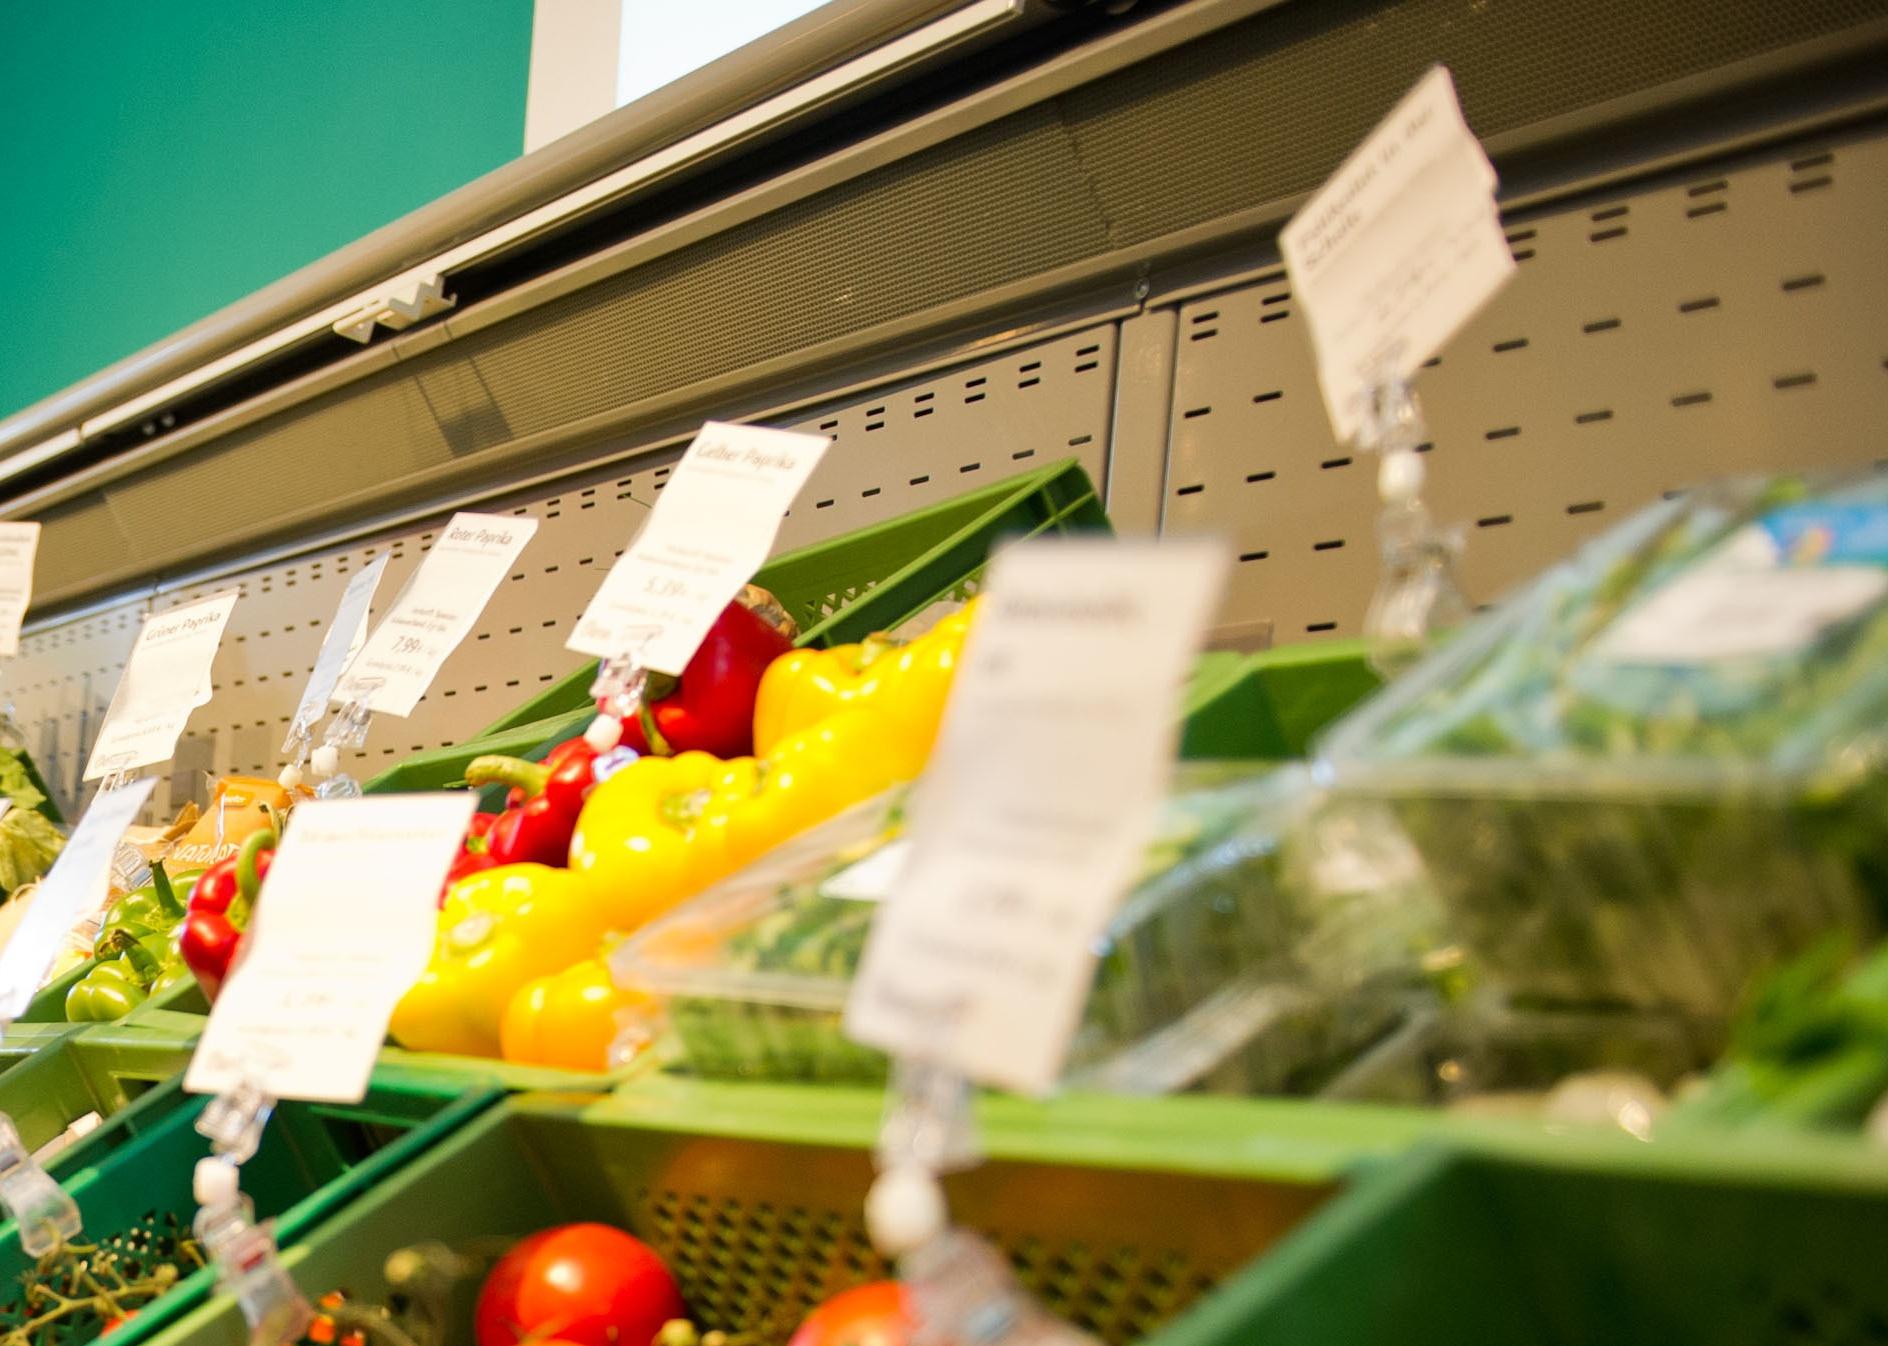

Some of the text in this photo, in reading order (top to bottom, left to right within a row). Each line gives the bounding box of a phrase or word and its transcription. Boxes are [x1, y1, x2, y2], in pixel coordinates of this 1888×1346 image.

[742, 447, 797, 472] Paprika
[448, 527, 513, 548] Roter Paprika
[145, 623, 179, 641] Grüner
[182, 612, 222, 631] Paprika
